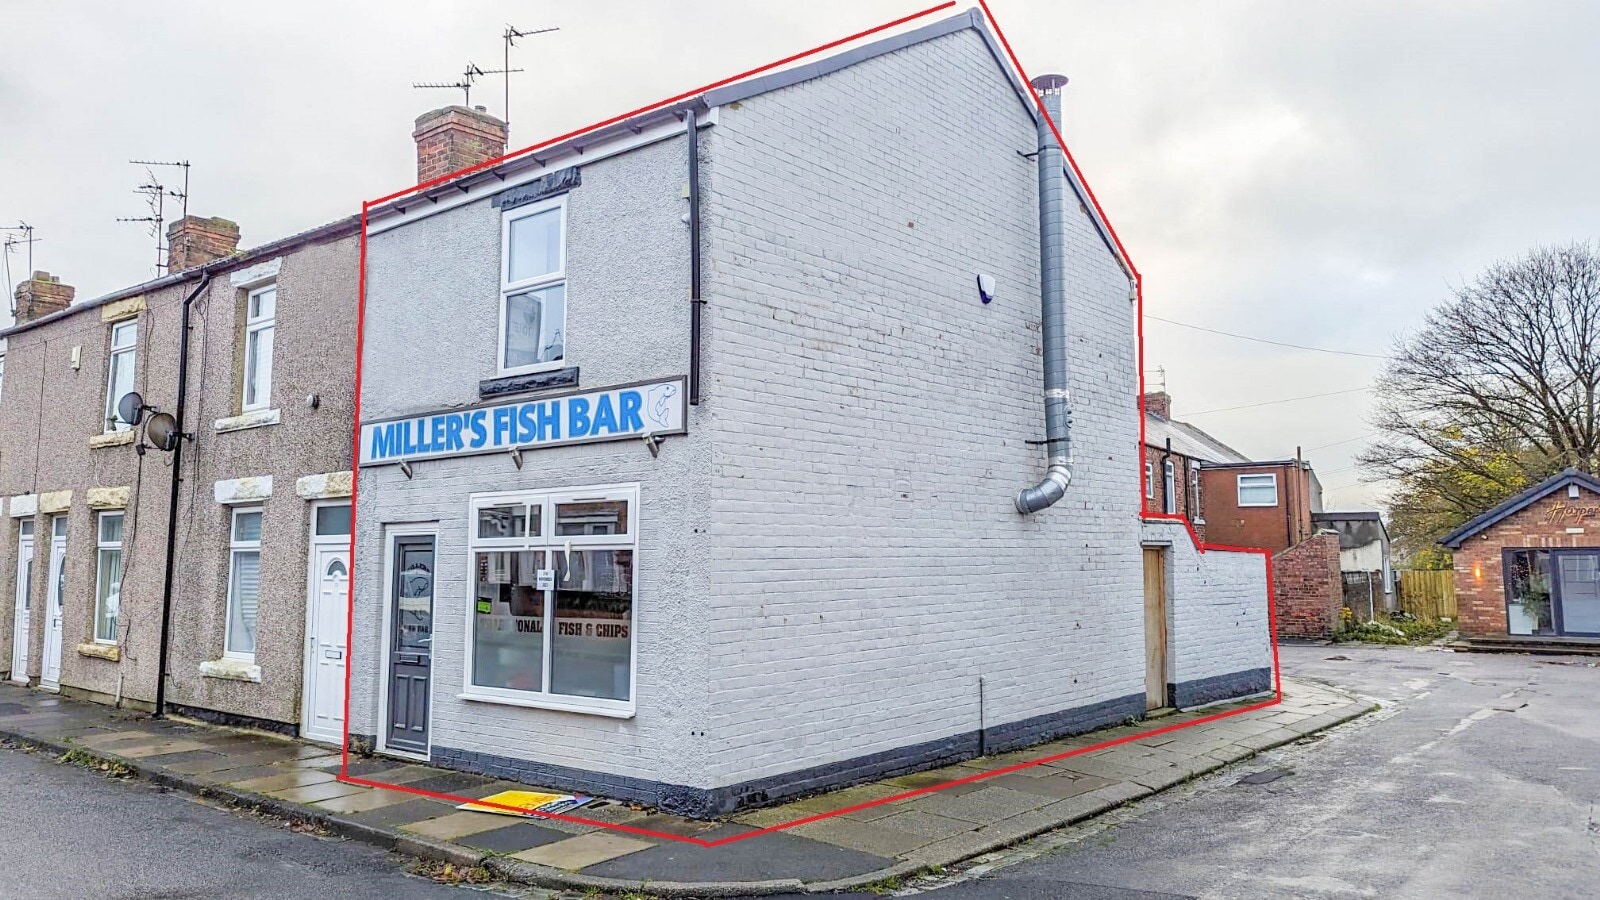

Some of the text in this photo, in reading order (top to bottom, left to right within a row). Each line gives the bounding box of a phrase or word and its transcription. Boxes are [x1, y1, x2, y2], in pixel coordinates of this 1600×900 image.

[371, 390, 644, 460] MILLER'S FISH BAR
[515, 619, 542, 633] ONAL
[558, 622, 582, 636] FISH
[586, 623, 593, 636] &
[596, 624, 628, 638] CHIPS
